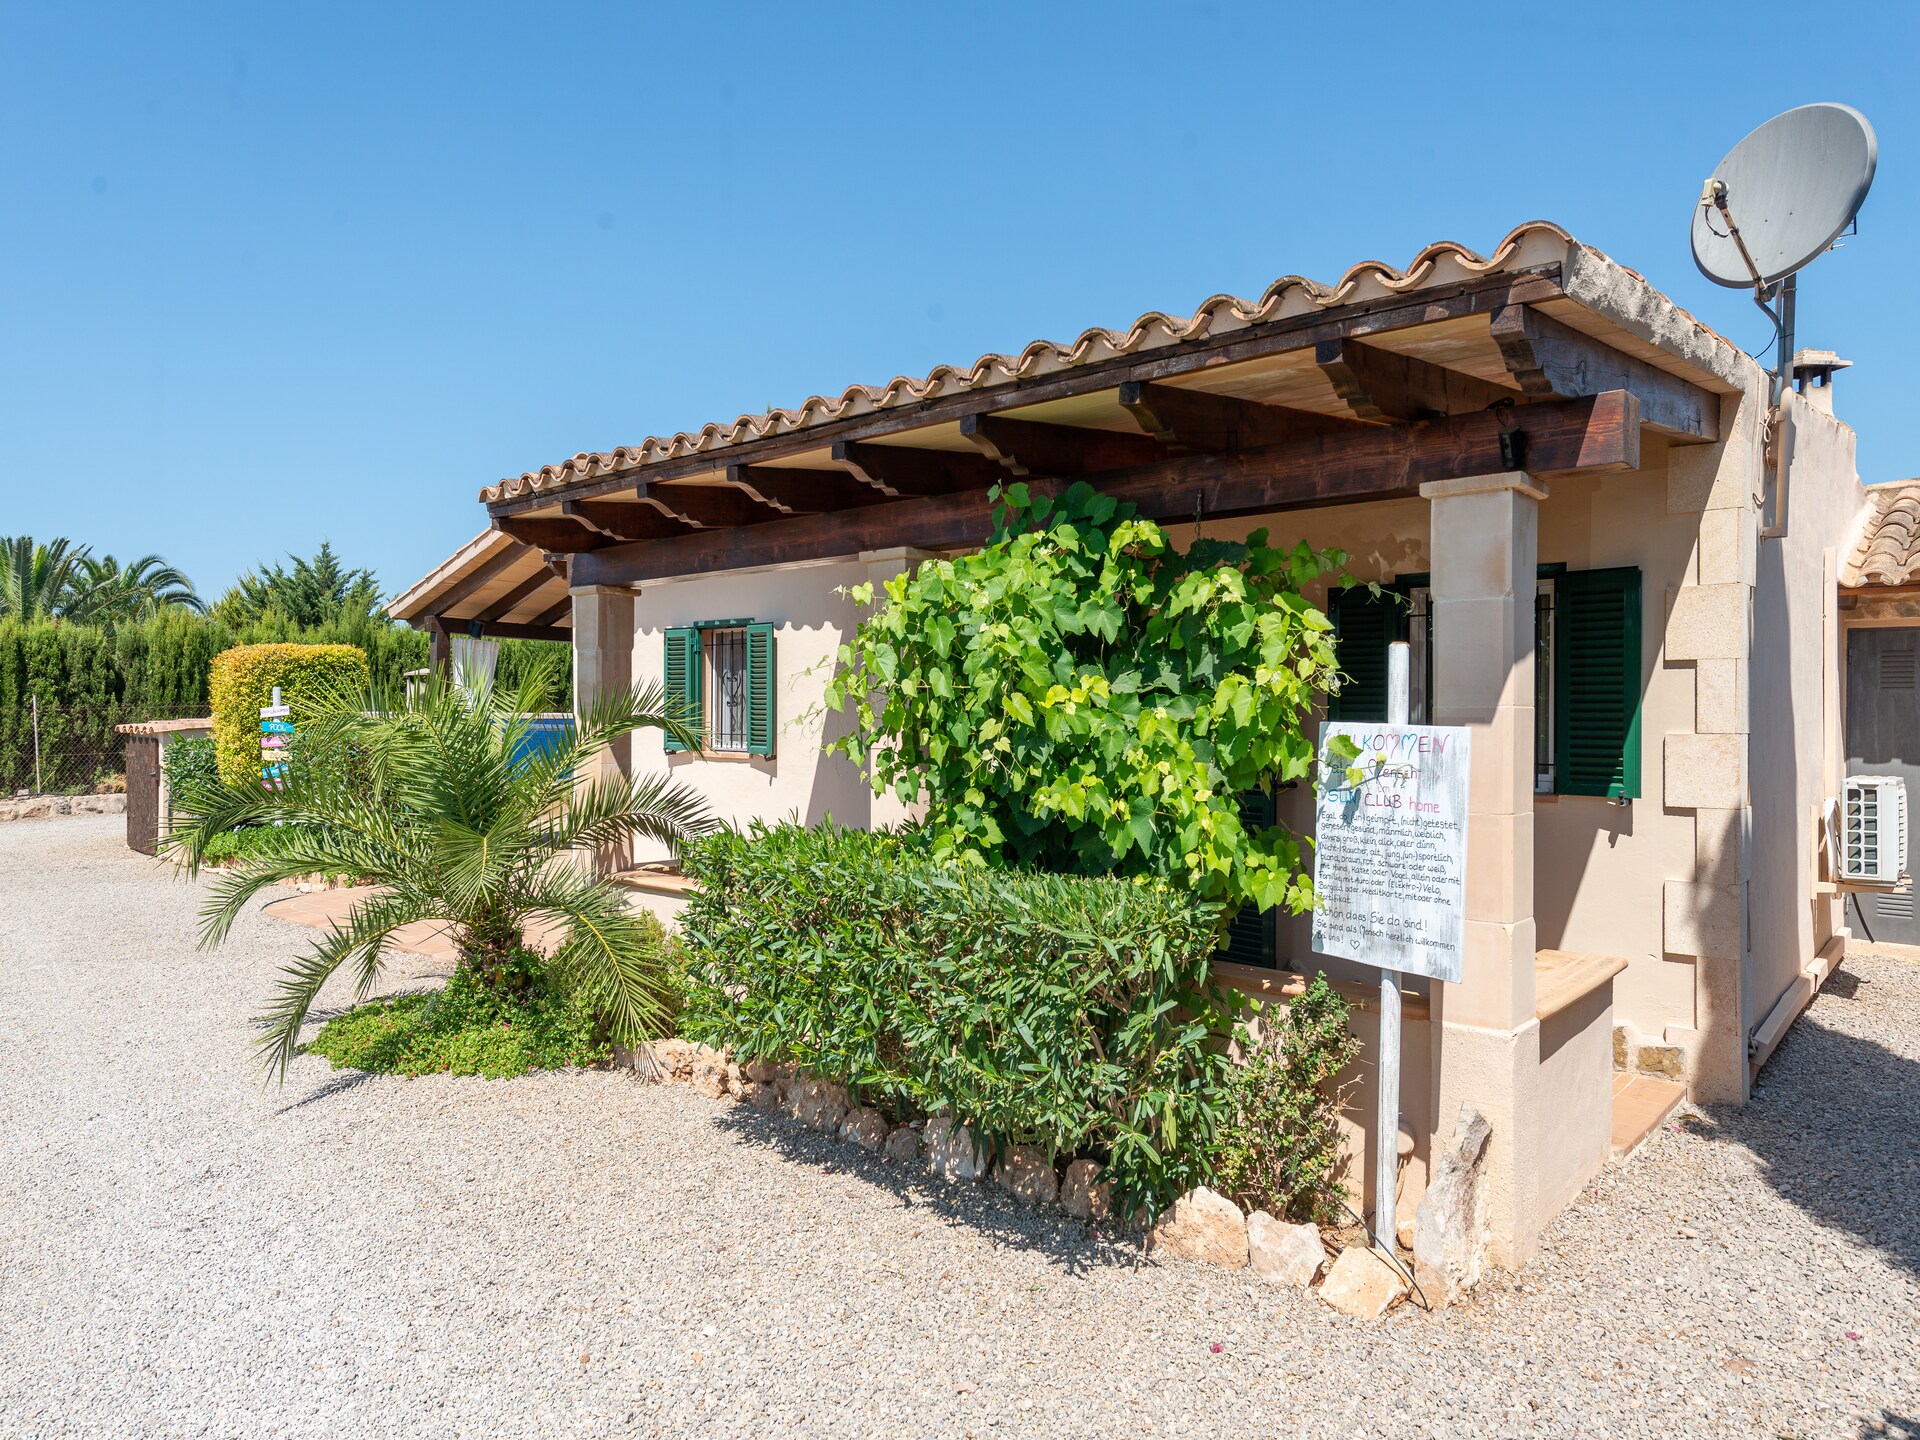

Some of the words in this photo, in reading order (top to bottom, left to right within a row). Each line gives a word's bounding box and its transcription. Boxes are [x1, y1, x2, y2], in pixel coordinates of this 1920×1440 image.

[269, 723, 286, 731] POOL
[1326, 729, 1450, 760] KOMMEN
[1328, 788, 1357, 804] SUN
[1365, 793, 1402, 808] CLUB
[1409, 796, 1440, 813] home
[1321, 811, 1336, 821] Egal
[1377, 860, 1406, 870] schwarz
[1409, 861, 1426, 871] oder
[1343, 876, 1354, 884] mit
[1355, 877, 1369, 885] Auto
[1371, 878, 1385, 886] oder
[1352, 865, 1369, 875] Katze
[1372, 868, 1388, 876] oder
[1411, 873, 1430, 882] allein
[1448, 876, 1461, 885] mit
[1405, 893, 1417, 901] mit
[1418, 895, 1432, 903] oder
[1434, 896, 1451, 906] ohne
[1346, 910, 1367, 922] dass
[1370, 911, 1385, 925] Sie
[1387, 914, 1400, 926] da
[1317, 918, 1327, 928] Sie
[1329, 922, 1343, 932] sind
[1346, 925, 1357, 934] als
[1360, 924, 1384, 938] Mensch
[1386, 931, 1414, 944] herzlich
[1415, 937, 1456, 952] willkommen
